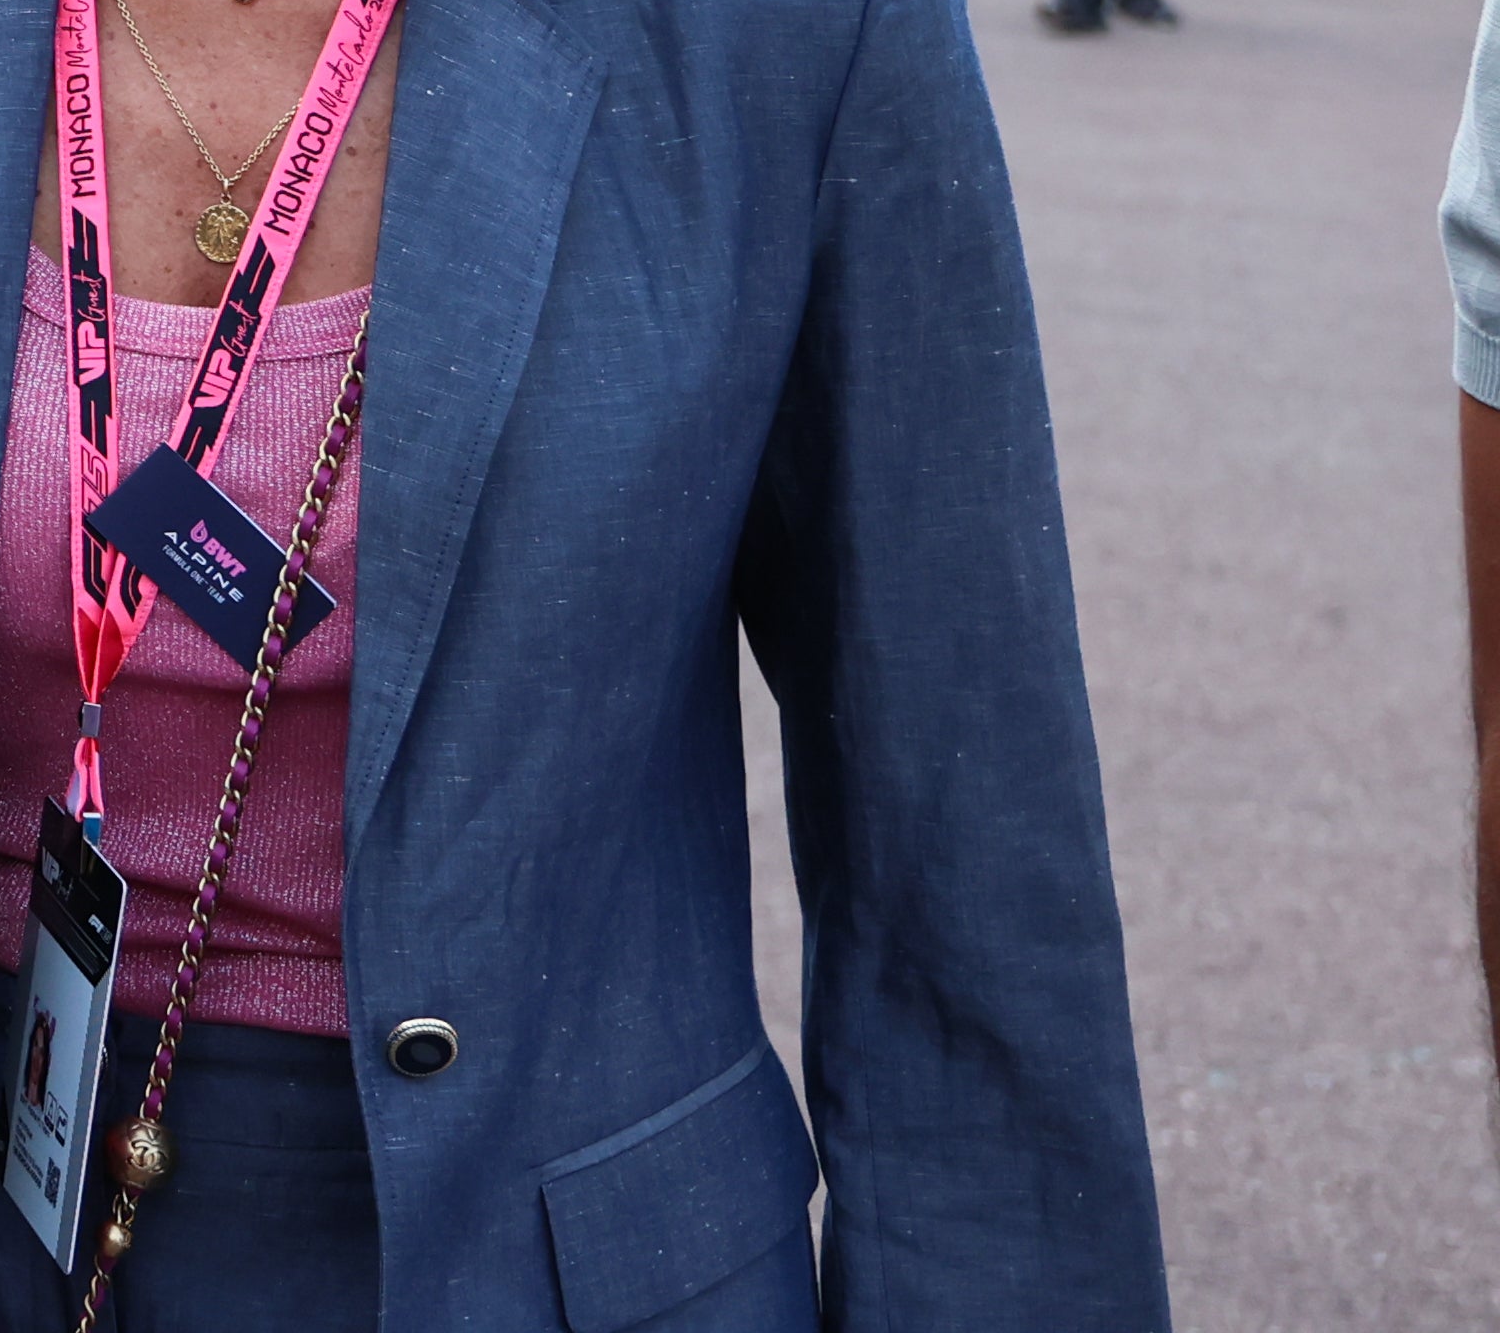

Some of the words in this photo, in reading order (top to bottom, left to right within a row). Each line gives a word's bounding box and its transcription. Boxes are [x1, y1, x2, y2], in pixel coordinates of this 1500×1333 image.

[67, 22, 95, 69] Monte
[67, 73, 97, 199] MONACO
[265, 111, 333, 236] MONACO
[318, 63, 356, 116] Monte
[342, 10, 374, 67] Carlo
[80, 263, 106, 324] Guest
[76, 319, 107, 387] VIP
[191, 345, 239, 406] VIP
[219, 299, 257, 358] Guest
[161, 543, 191, 573] FORMULA
[206, 584, 226, 604] TEAM
[163, 527, 244, 604] ALPINE
[203, 535, 247, 580] BWT
